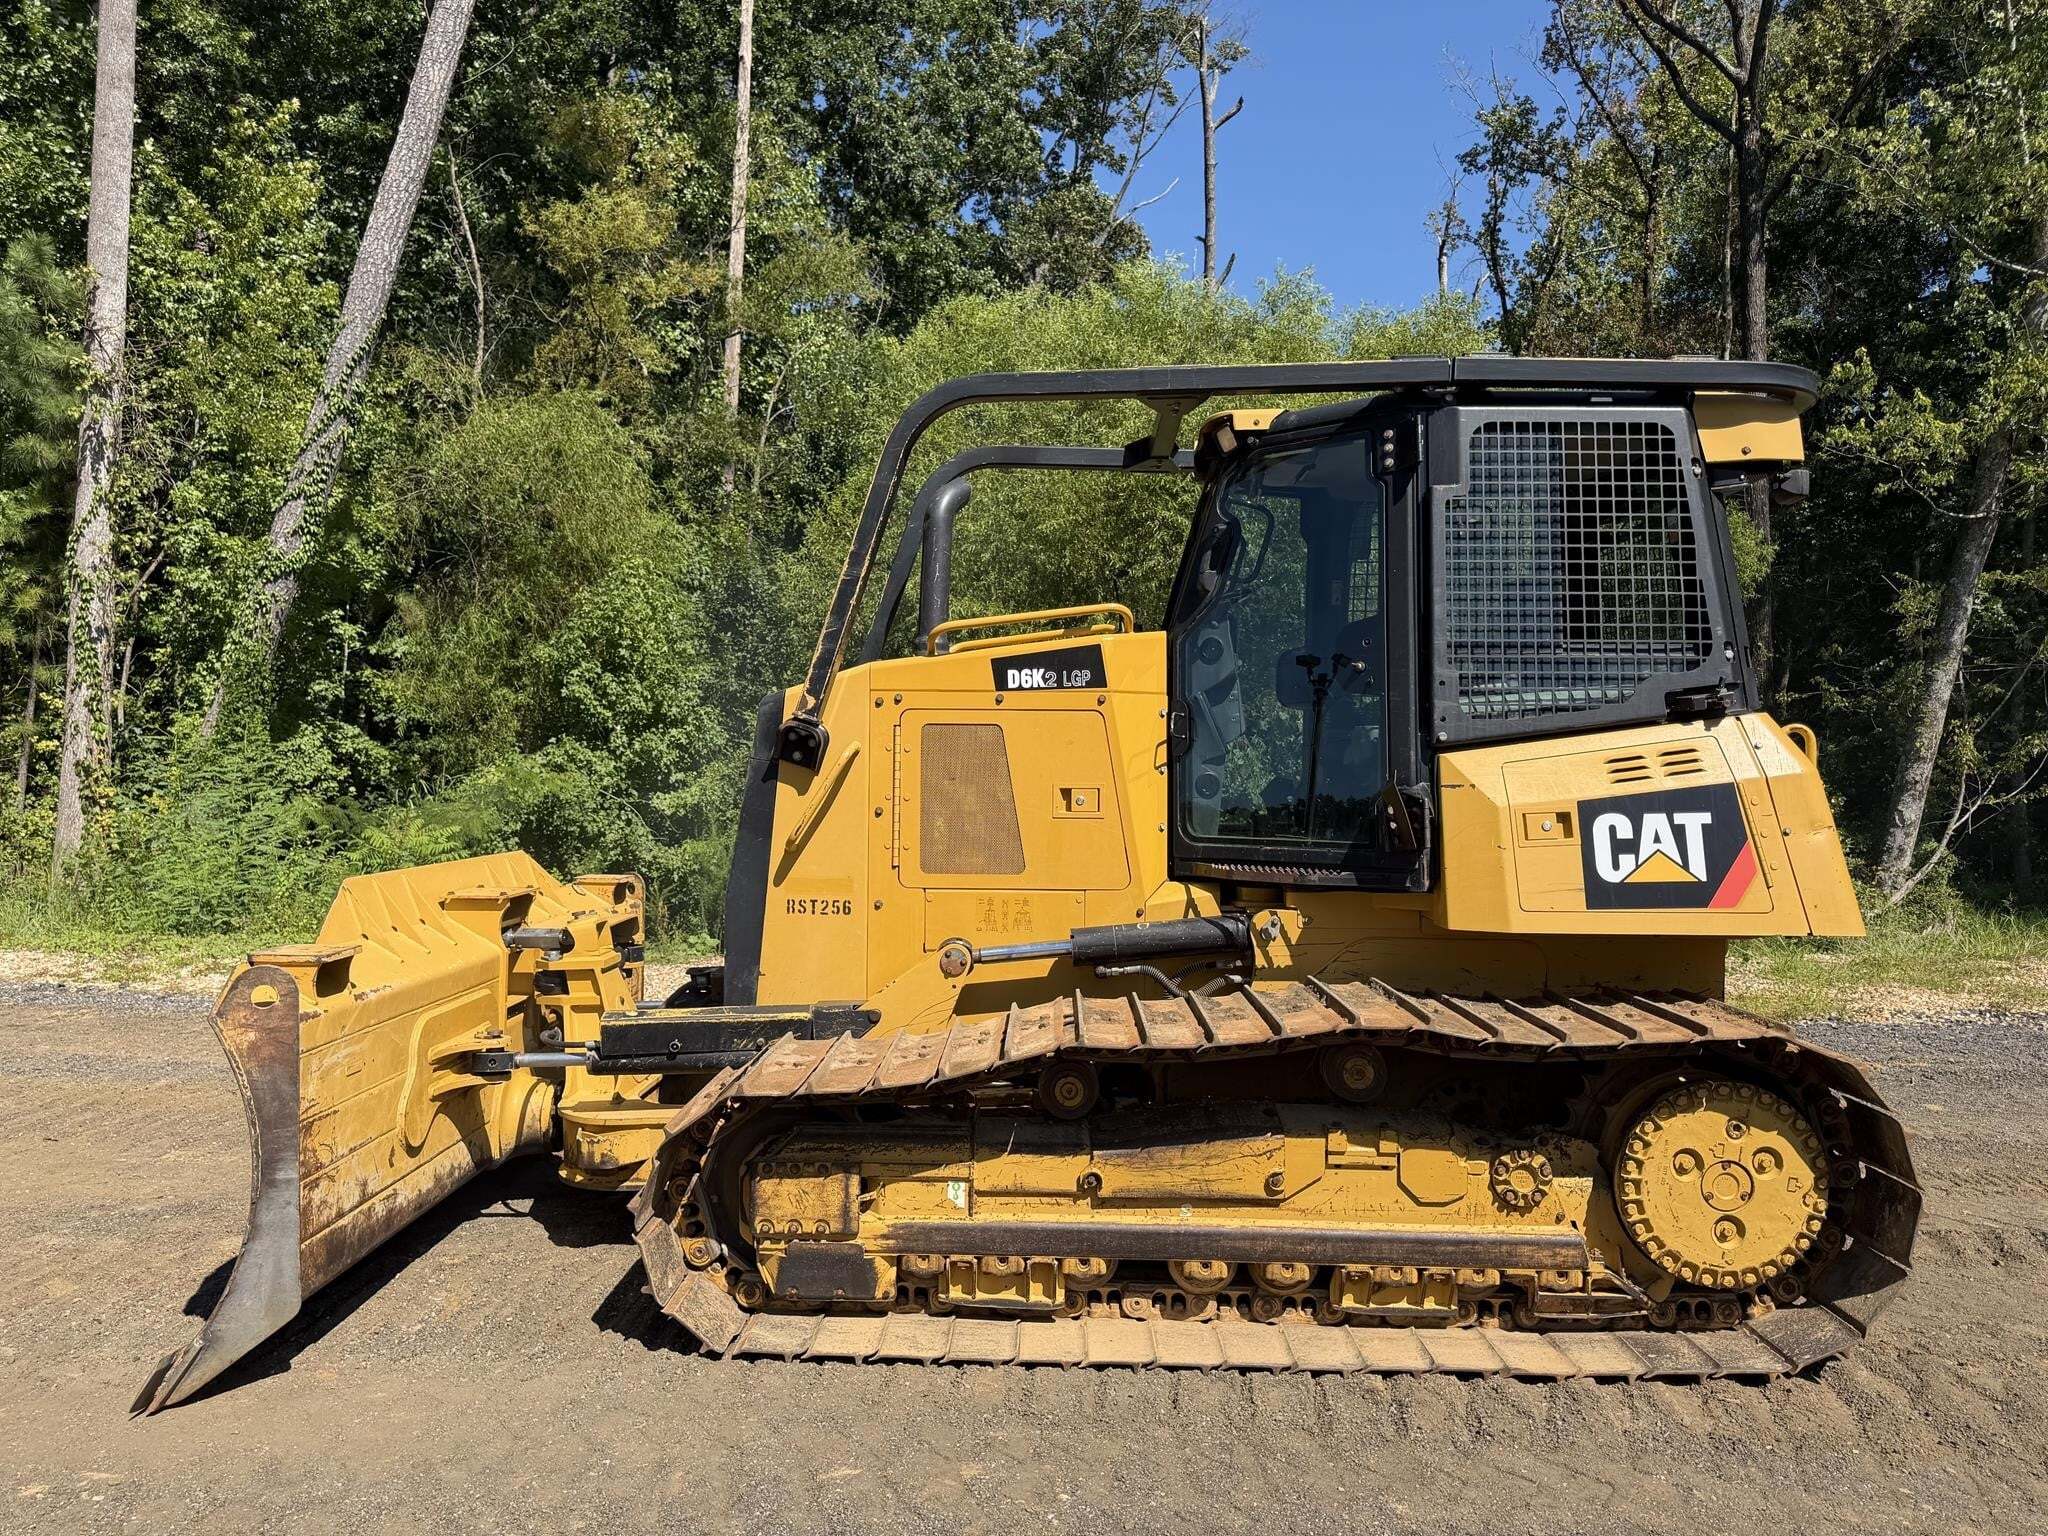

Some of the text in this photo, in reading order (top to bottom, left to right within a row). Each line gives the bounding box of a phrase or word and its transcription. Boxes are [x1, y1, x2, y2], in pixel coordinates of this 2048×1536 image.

[1007, 668, 1091, 689] D6K2 LGP
[1592, 812, 1712, 883] CAT
